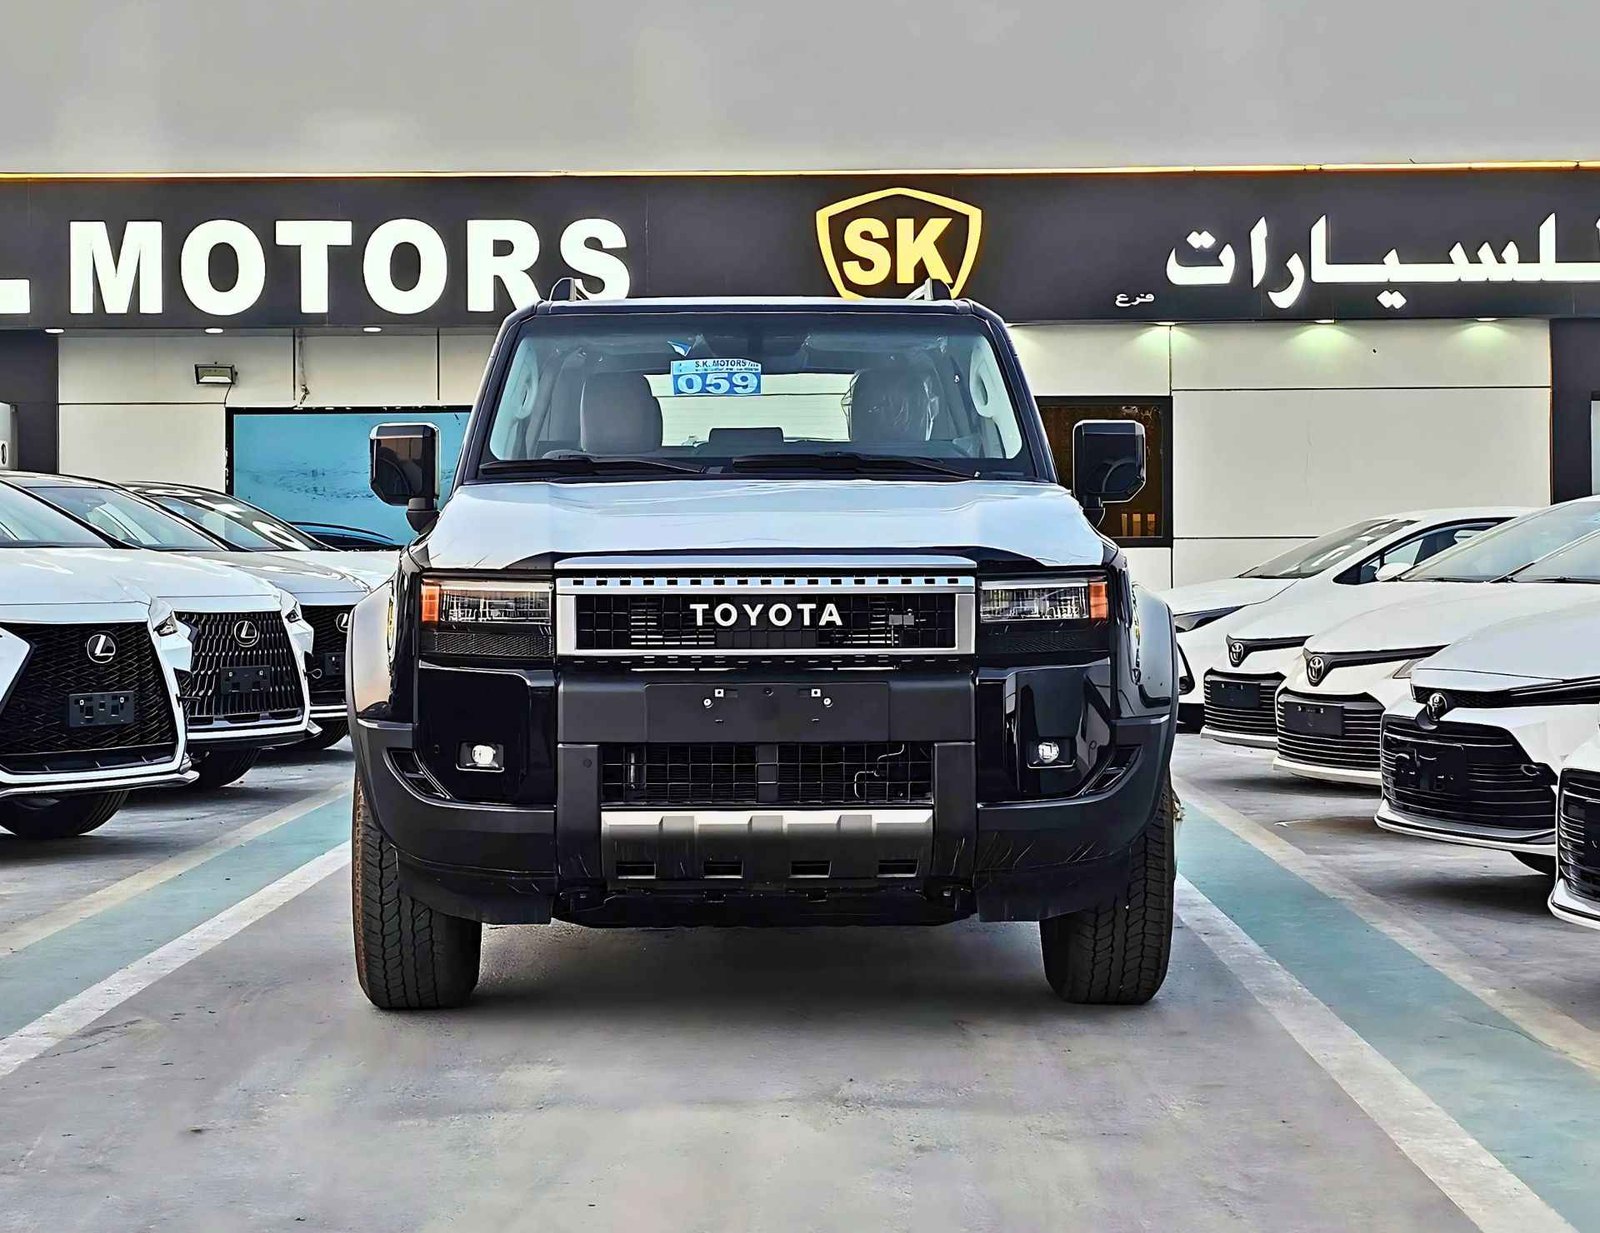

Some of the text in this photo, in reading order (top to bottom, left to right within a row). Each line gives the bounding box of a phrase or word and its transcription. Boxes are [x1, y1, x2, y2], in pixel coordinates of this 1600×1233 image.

[69, 219, 631, 316] MOTORS
[842, 217, 954, 286] SK
[1166, 212, 1600, 310] لسيارات
[677, 373, 758, 394] 059
[713, 359, 747, 367] MOTORS
[689, 603, 843, 627] TOYOTA
